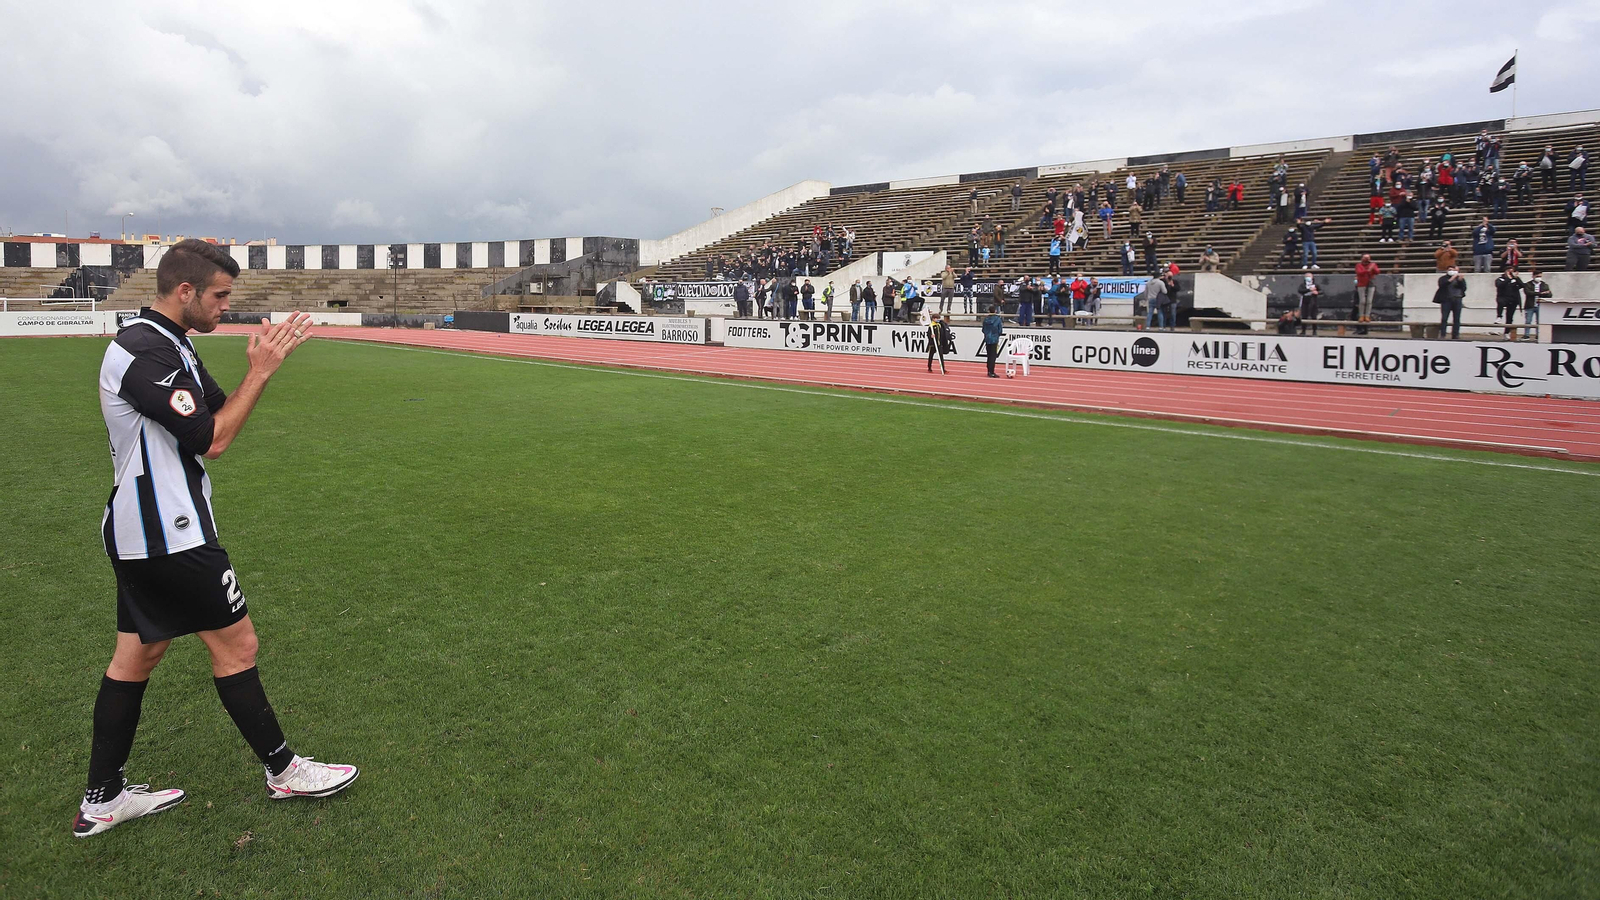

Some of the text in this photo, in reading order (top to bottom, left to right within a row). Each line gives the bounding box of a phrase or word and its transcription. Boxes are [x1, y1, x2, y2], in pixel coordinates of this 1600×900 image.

[516, 319, 538, 331] aqualia
[577, 319, 655, 334] LEGEA LEGEA
[661, 329, 699, 342] BARROSO
[812, 323, 878, 345] PRINT
[826, 344, 849, 352] POWER
[1072, 345, 1128, 366] GPON
[1187, 340, 1289, 362] MIREIA
[1187, 360, 1288, 374] RESTAURANTE
[1323, 345, 1451, 380] El Monje
